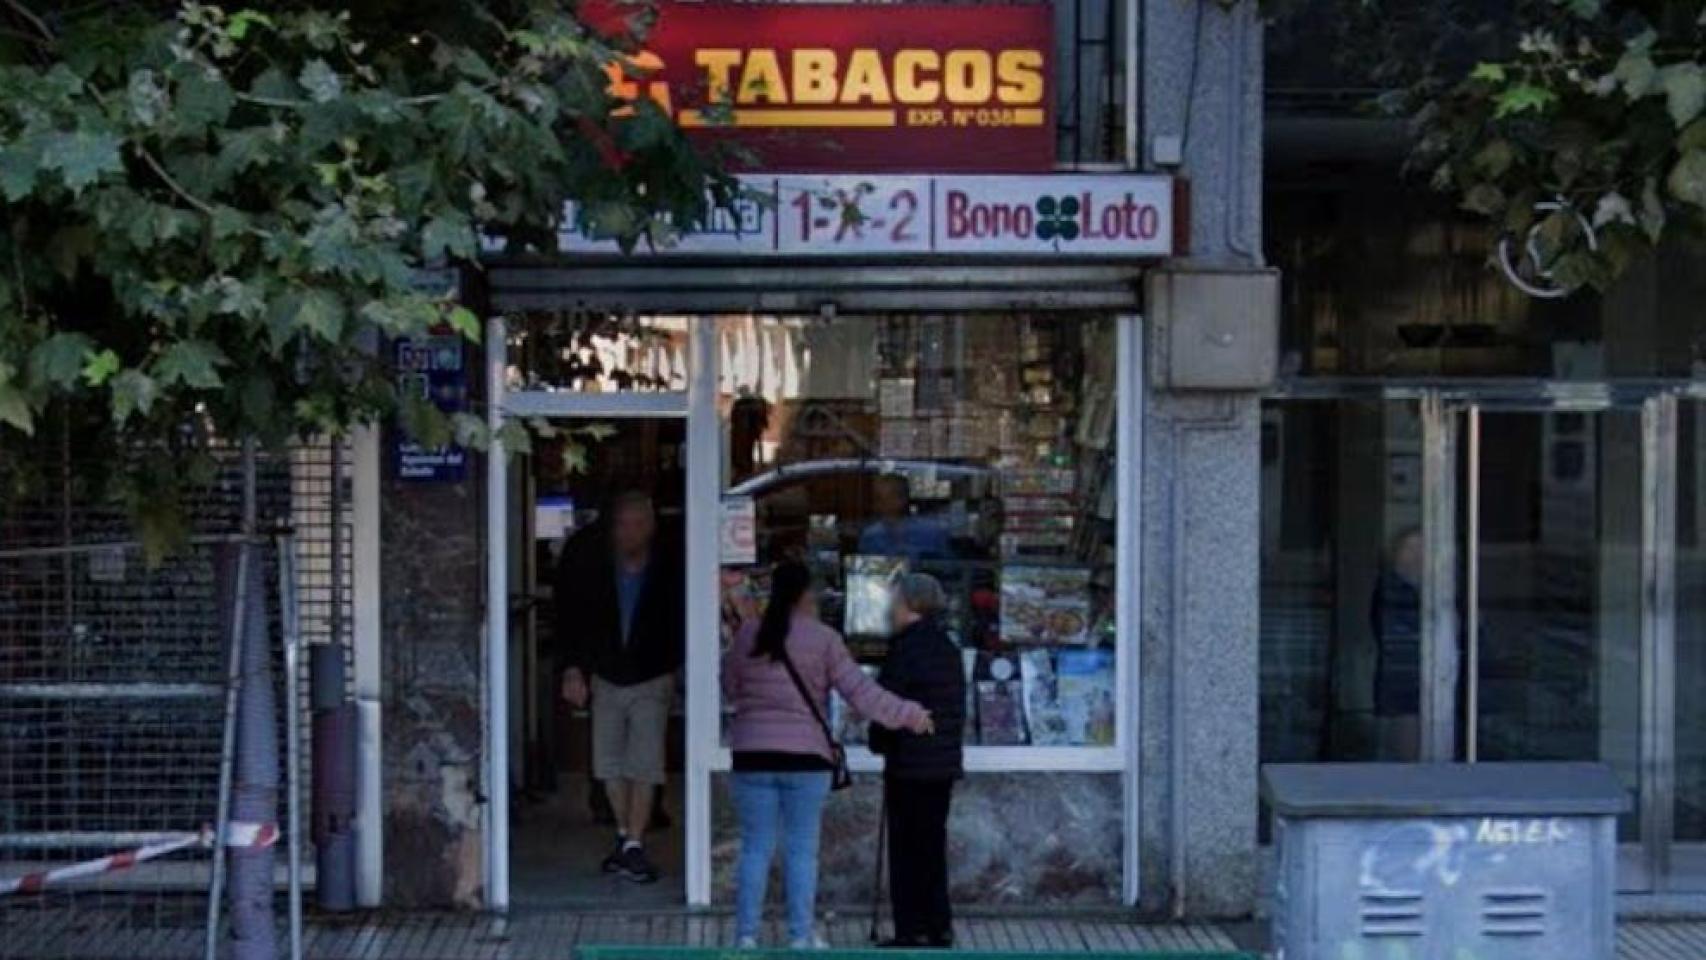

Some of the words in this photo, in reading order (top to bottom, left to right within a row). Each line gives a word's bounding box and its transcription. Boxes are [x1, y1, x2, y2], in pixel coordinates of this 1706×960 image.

[694, 48, 1044, 105] TABACOS
[907, 108, 947, 127] EXP.
[946, 189, 1034, 240] Bono
[1081, 191, 1159, 240] Loto
